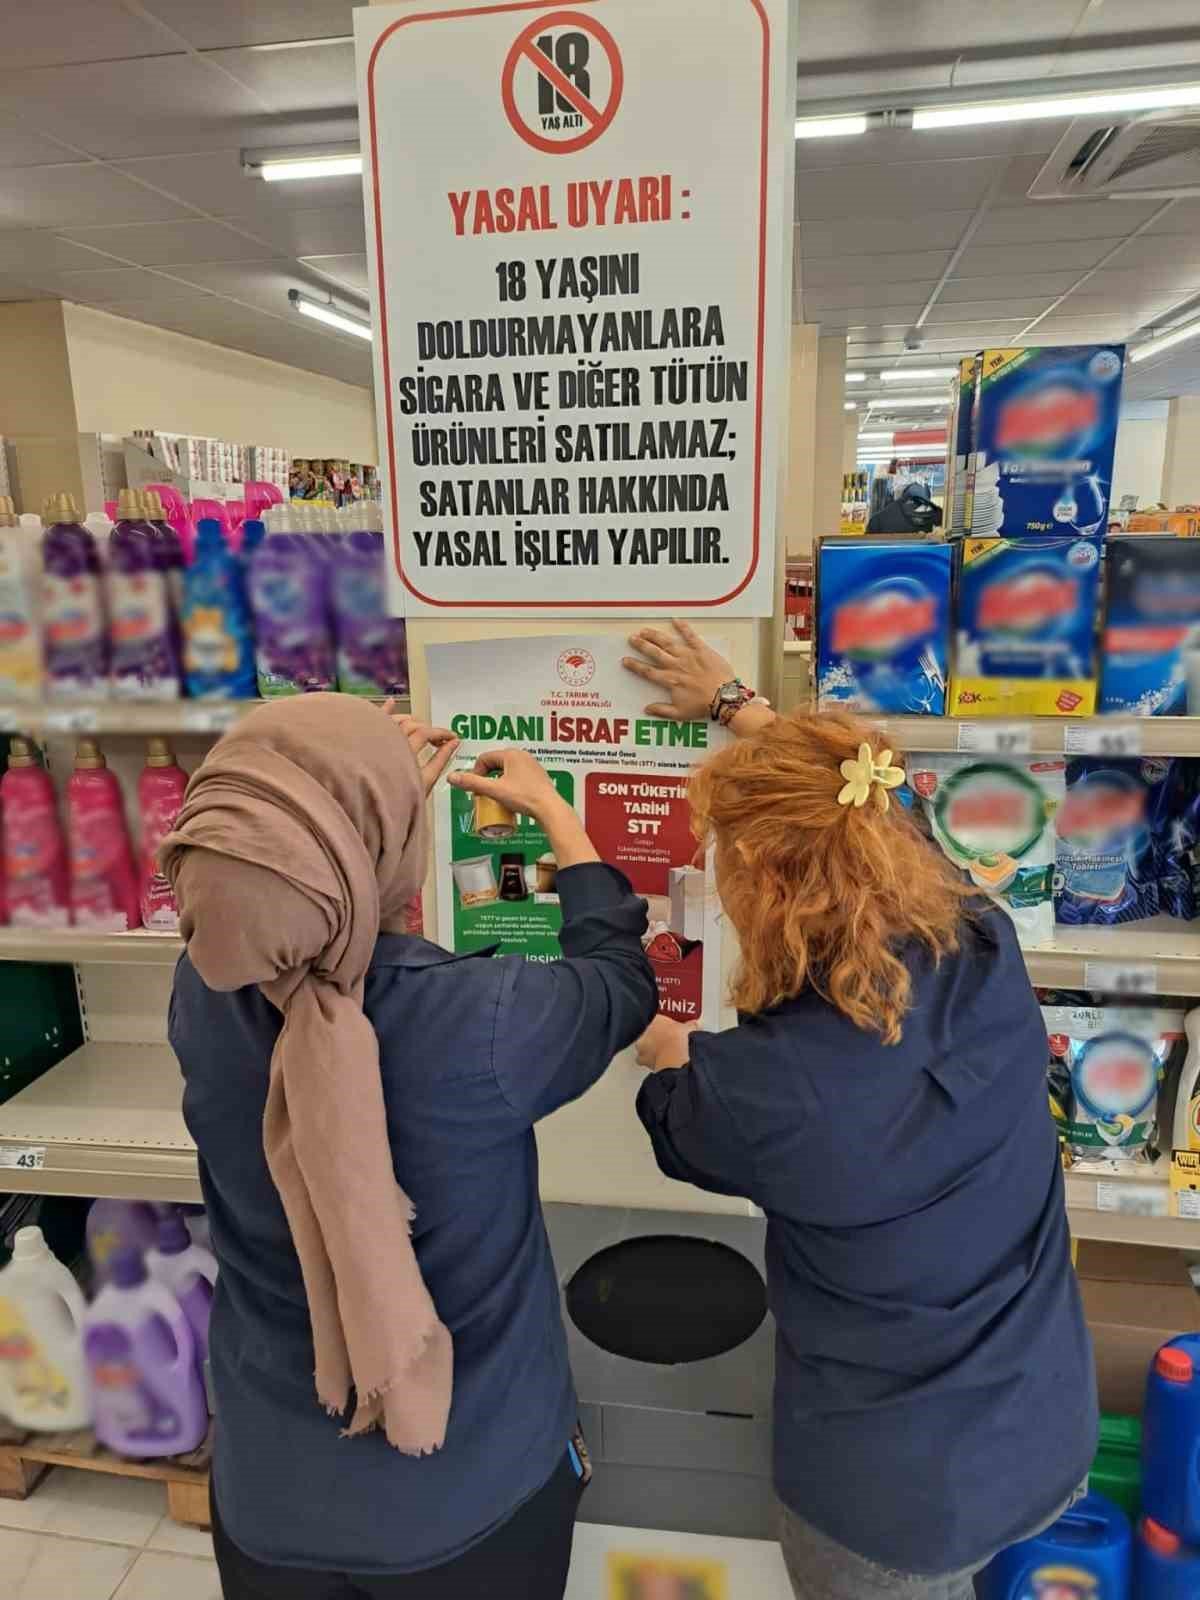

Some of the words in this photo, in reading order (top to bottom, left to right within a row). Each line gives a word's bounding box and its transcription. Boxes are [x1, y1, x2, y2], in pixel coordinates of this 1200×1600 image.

[536, 32, 590, 115] 18
[541, 116, 560, 130] YAŞ
[563, 114, 583, 128] ALTI
[447, 185, 557, 236] YASAL
[567, 174, 672, 228] UYARI
[495, 261, 526, 302] 18
[535, 252, 640, 303] YAŞINI
[417, 305, 725, 361] DOLDURMAYANLARA
[399, 367, 505, 415] SİGARA
[513, 372, 550, 411] VE
[558, 359, 640, 409] DİĞER
[650, 355, 748, 405] TÜTÜN
[412, 415, 547, 466] ÜRÜNLERİ
[555, 418, 737, 463] SATILAMAZ;
[419, 478, 570, 517] SATANLAR
[578, 473, 729, 515] HAKKINDA
[413, 530, 507, 567] YASAL
[515, 521, 599, 572] İŞLEM
[607, 527, 730, 565] YAPILIR.
[565, 691, 589, 699] TARIM
[451, 714, 544, 742] GIDANI
[550, 711, 629, 745] İSRAF
[634, 719, 708, 749] ETME
[598, 783, 628, 796] SON
[623, 801, 670, 816] TARİHİ
[627, 818, 661, 835] STT
[16, 1154, 35, 1168] 43
